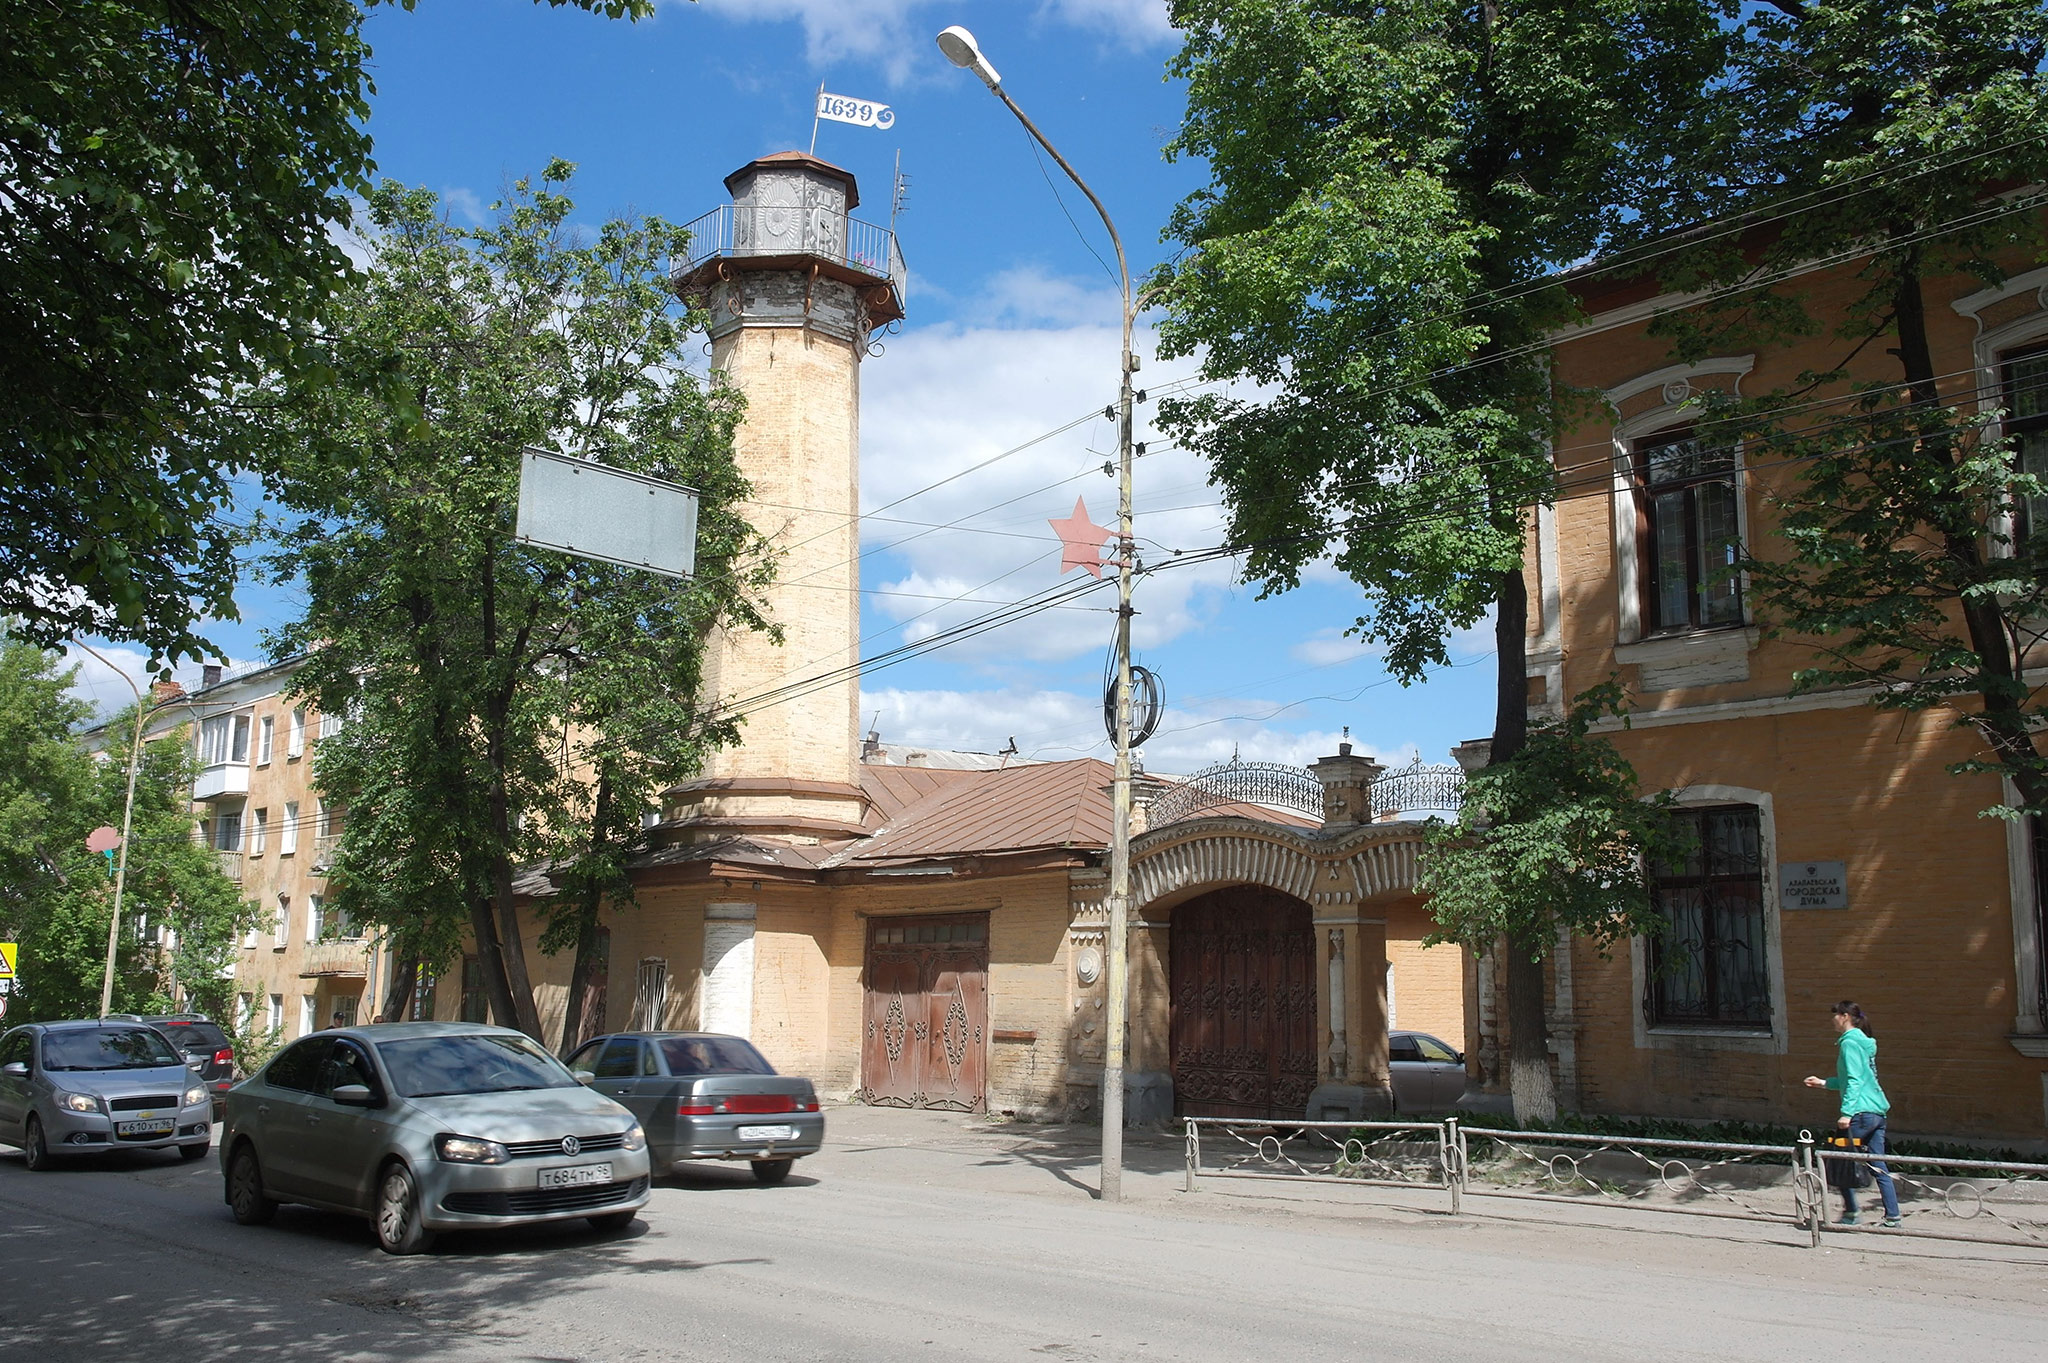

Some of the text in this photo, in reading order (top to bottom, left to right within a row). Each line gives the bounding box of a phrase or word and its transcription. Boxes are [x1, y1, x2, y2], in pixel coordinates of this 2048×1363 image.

[821, 96, 873, 122] 1639
[1785, 886, 1841, 897] ГОРОДСКАЯ
[1799, 896, 1827, 906] ДУМА
